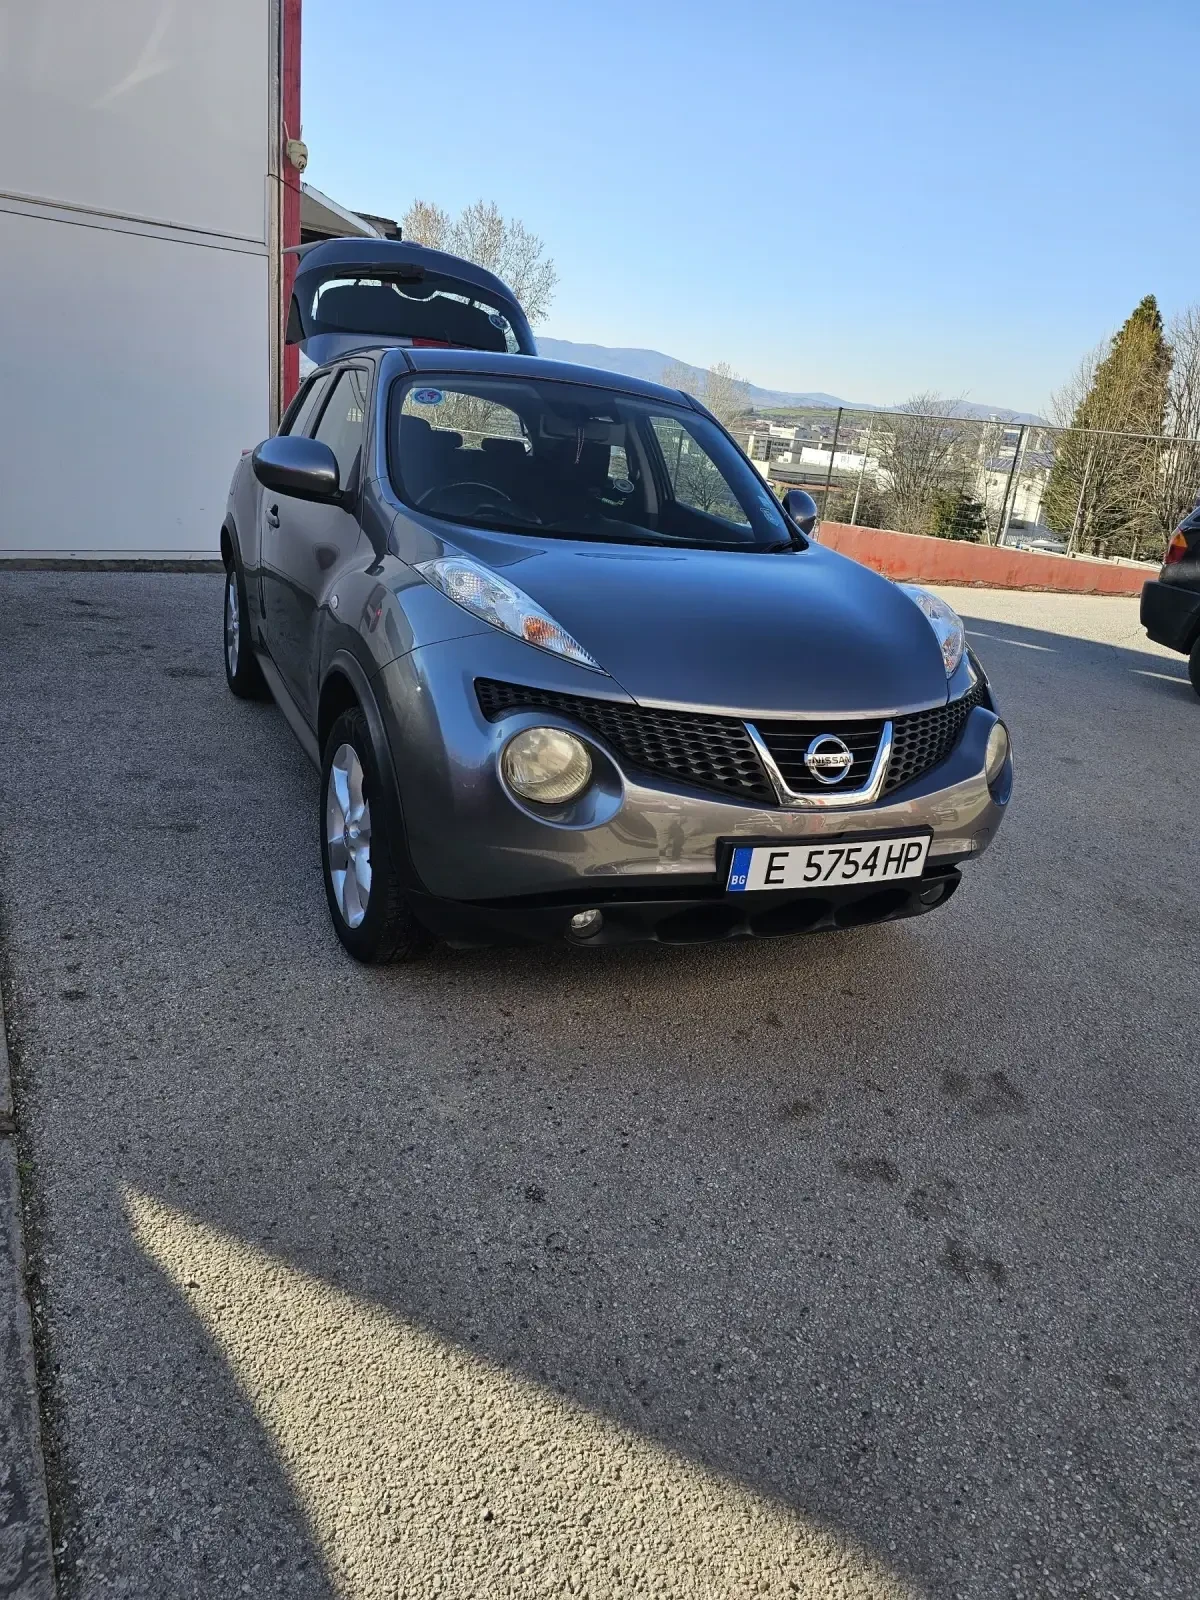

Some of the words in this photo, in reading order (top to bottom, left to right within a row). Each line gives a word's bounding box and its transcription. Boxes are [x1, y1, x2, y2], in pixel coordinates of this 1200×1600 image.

[812, 756, 851, 765] NISSAN
[764, 852, 789, 884] E
[731, 875, 746, 885] BG
